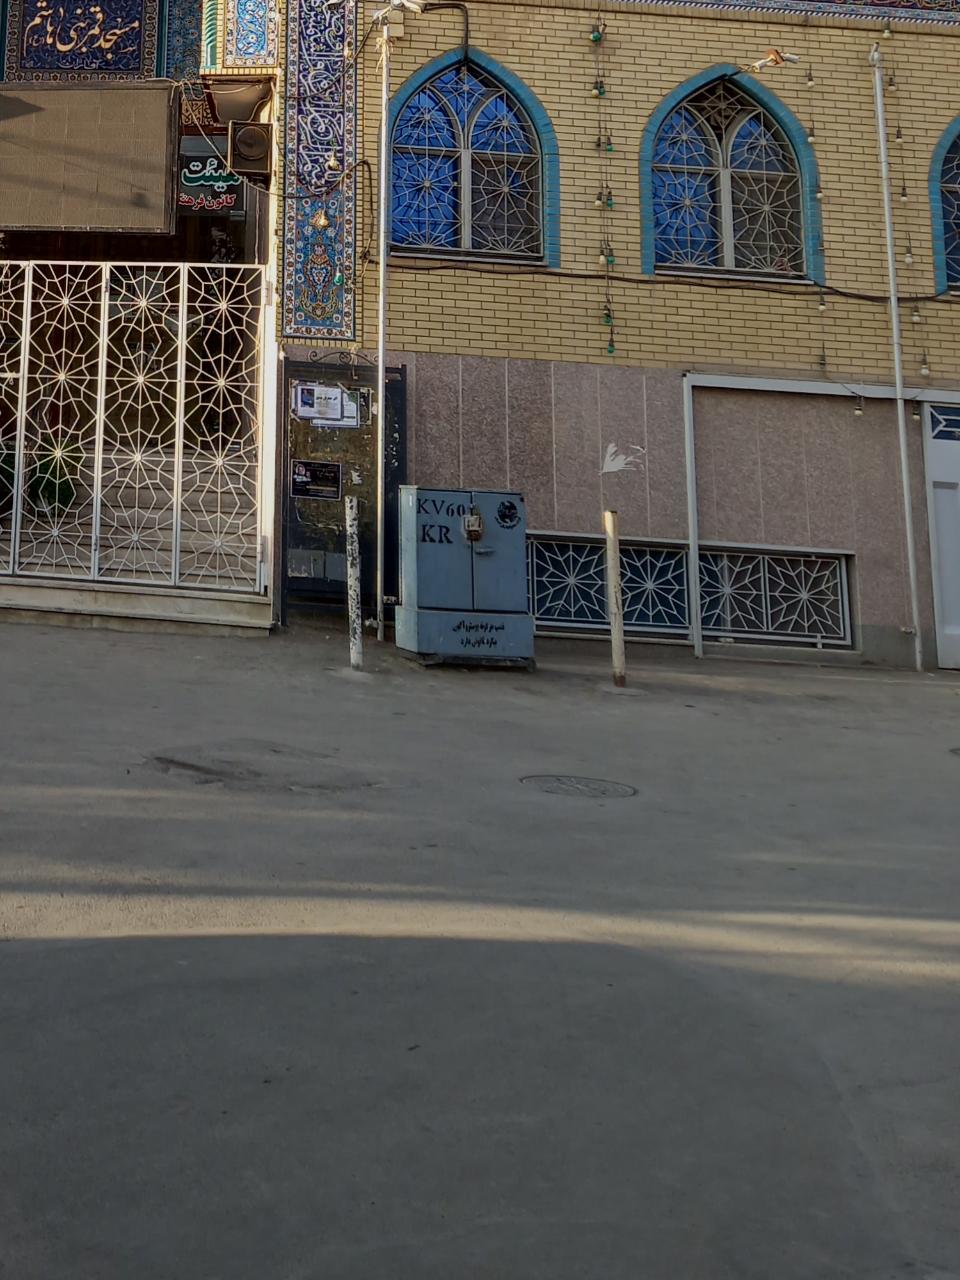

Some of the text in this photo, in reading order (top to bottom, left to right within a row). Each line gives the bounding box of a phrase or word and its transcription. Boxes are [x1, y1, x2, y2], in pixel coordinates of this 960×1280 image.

[73, 5, 104, 50] قمر
[91, 17, 140, 60] مسجد
[421, 524, 454, 544] KR
